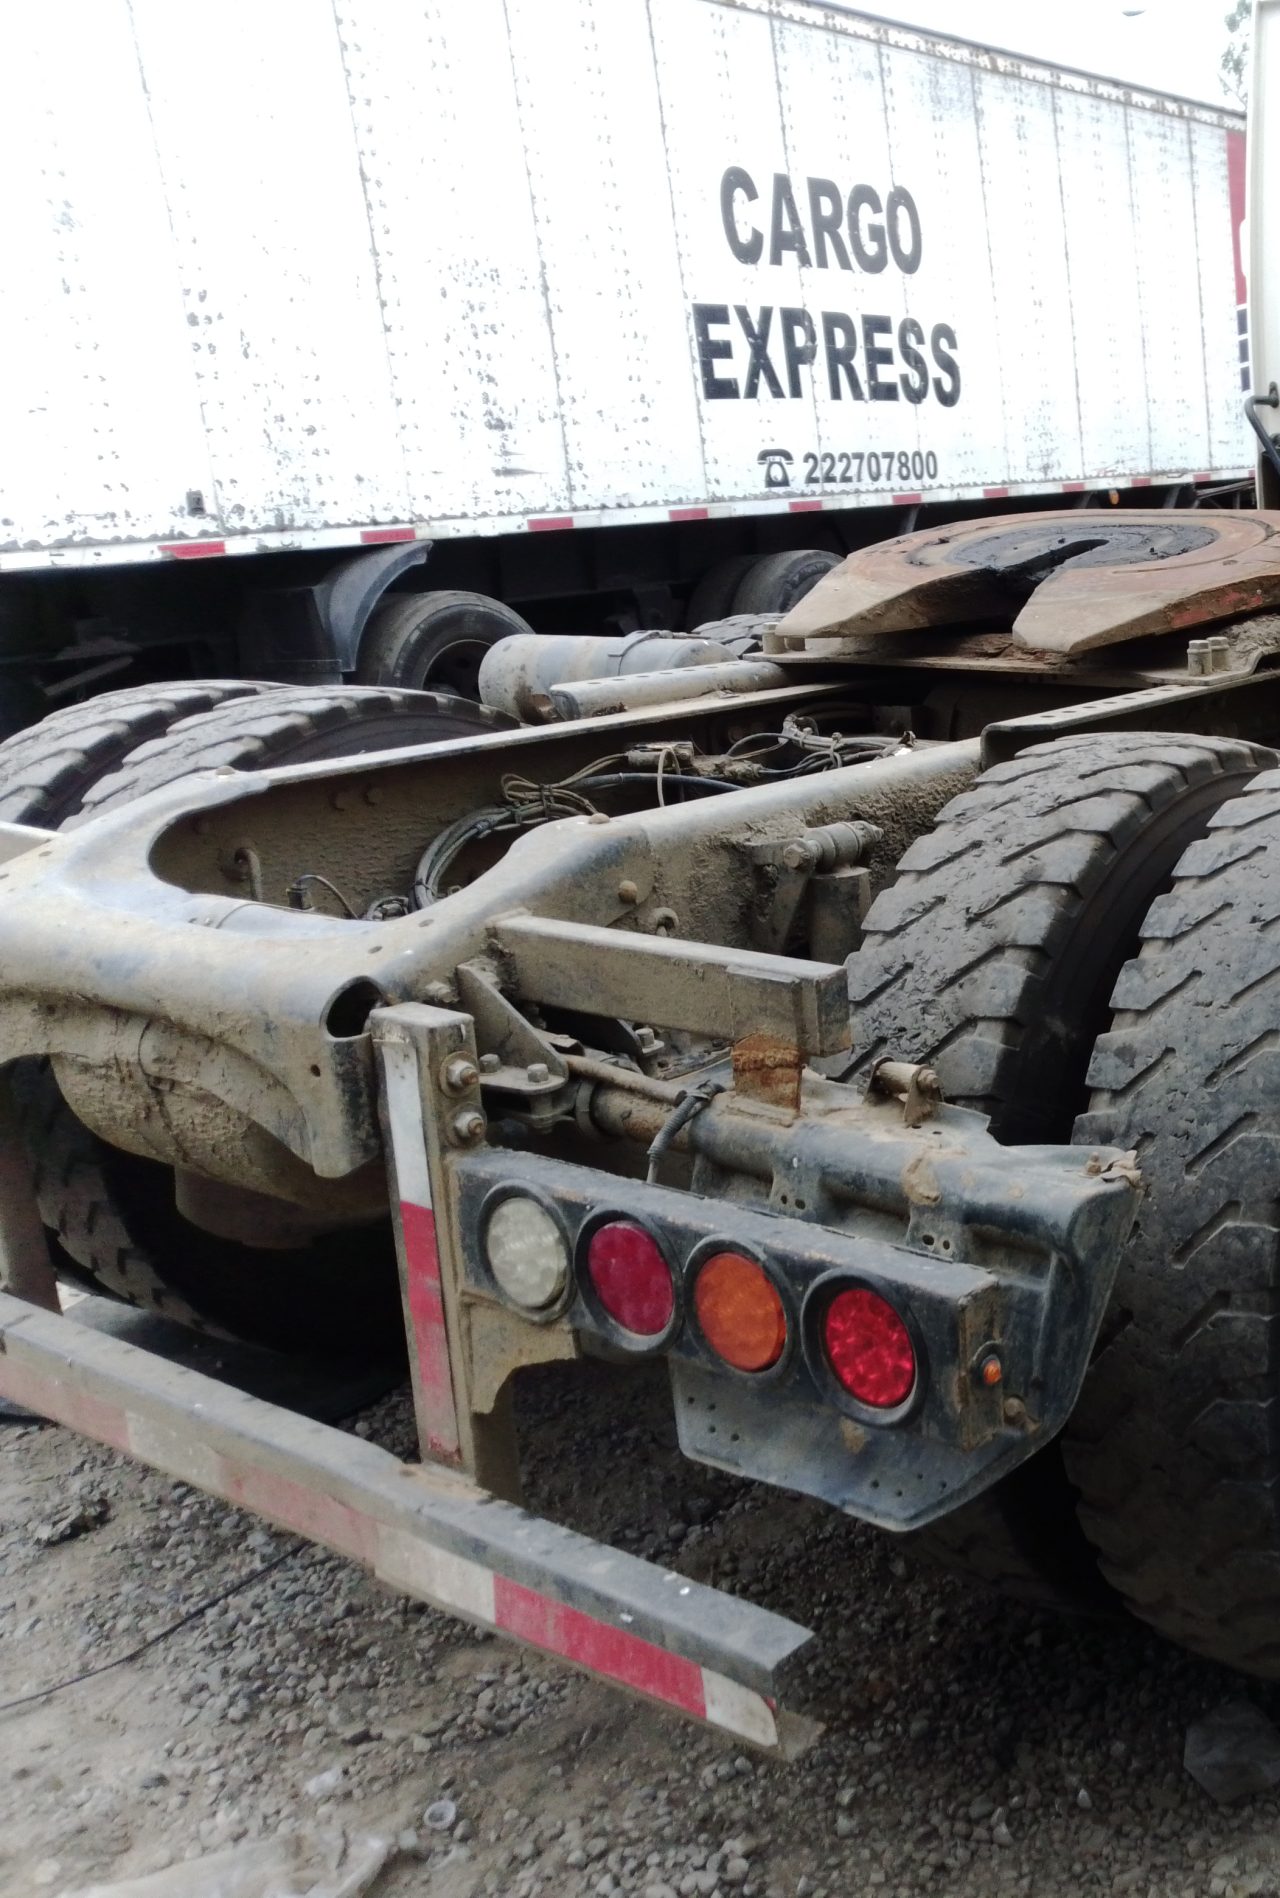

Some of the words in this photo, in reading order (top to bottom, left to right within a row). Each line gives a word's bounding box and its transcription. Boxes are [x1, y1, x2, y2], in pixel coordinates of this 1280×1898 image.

[720, 165, 922, 274] CARGO
[691, 303, 961, 408] EXPRESS
[802, 450, 939, 484] 222707800
